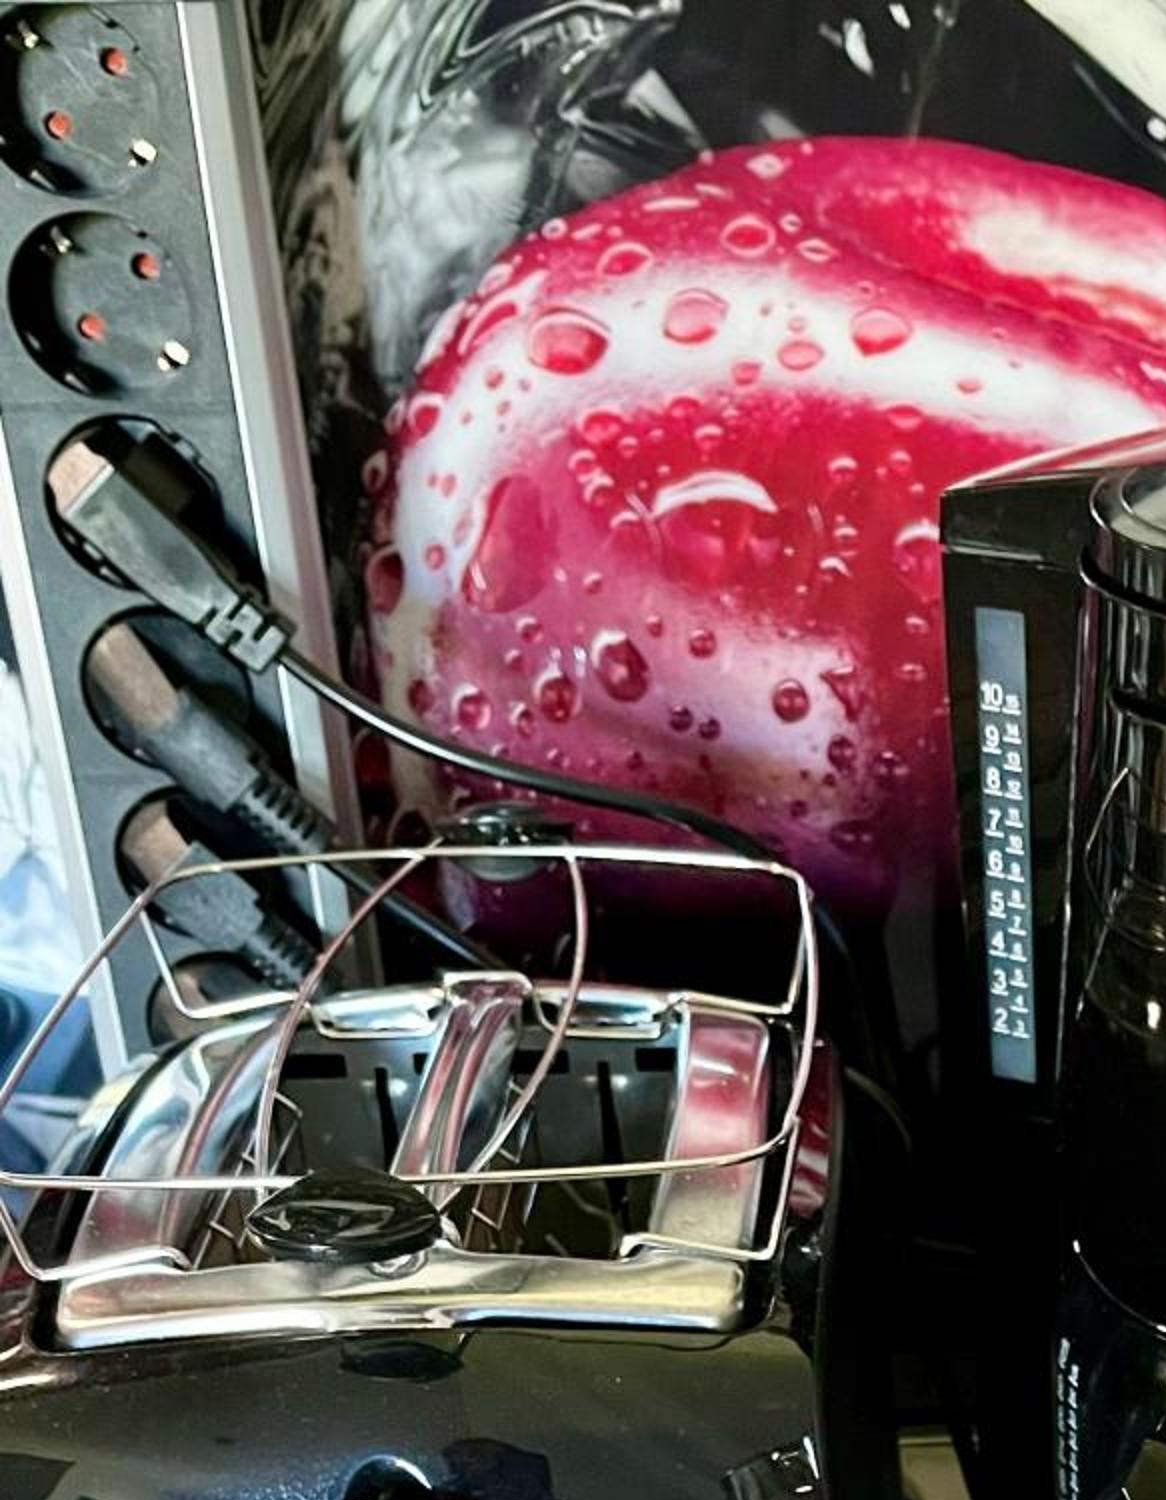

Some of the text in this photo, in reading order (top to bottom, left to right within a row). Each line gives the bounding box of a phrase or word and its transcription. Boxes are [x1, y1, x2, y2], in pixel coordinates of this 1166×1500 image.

[981, 682, 1002, 706] 10
[985, 725, 999, 747] 9
[987, 767, 1000, 789] 8
[988, 808, 1001, 831] 7
[989, 850, 1002, 872] 6
[991, 890, 1004, 913] 5
[991, 931, 1005, 952] 4
[993, 968, 1006, 990] 3
[994, 1007, 1008, 1029] 2
